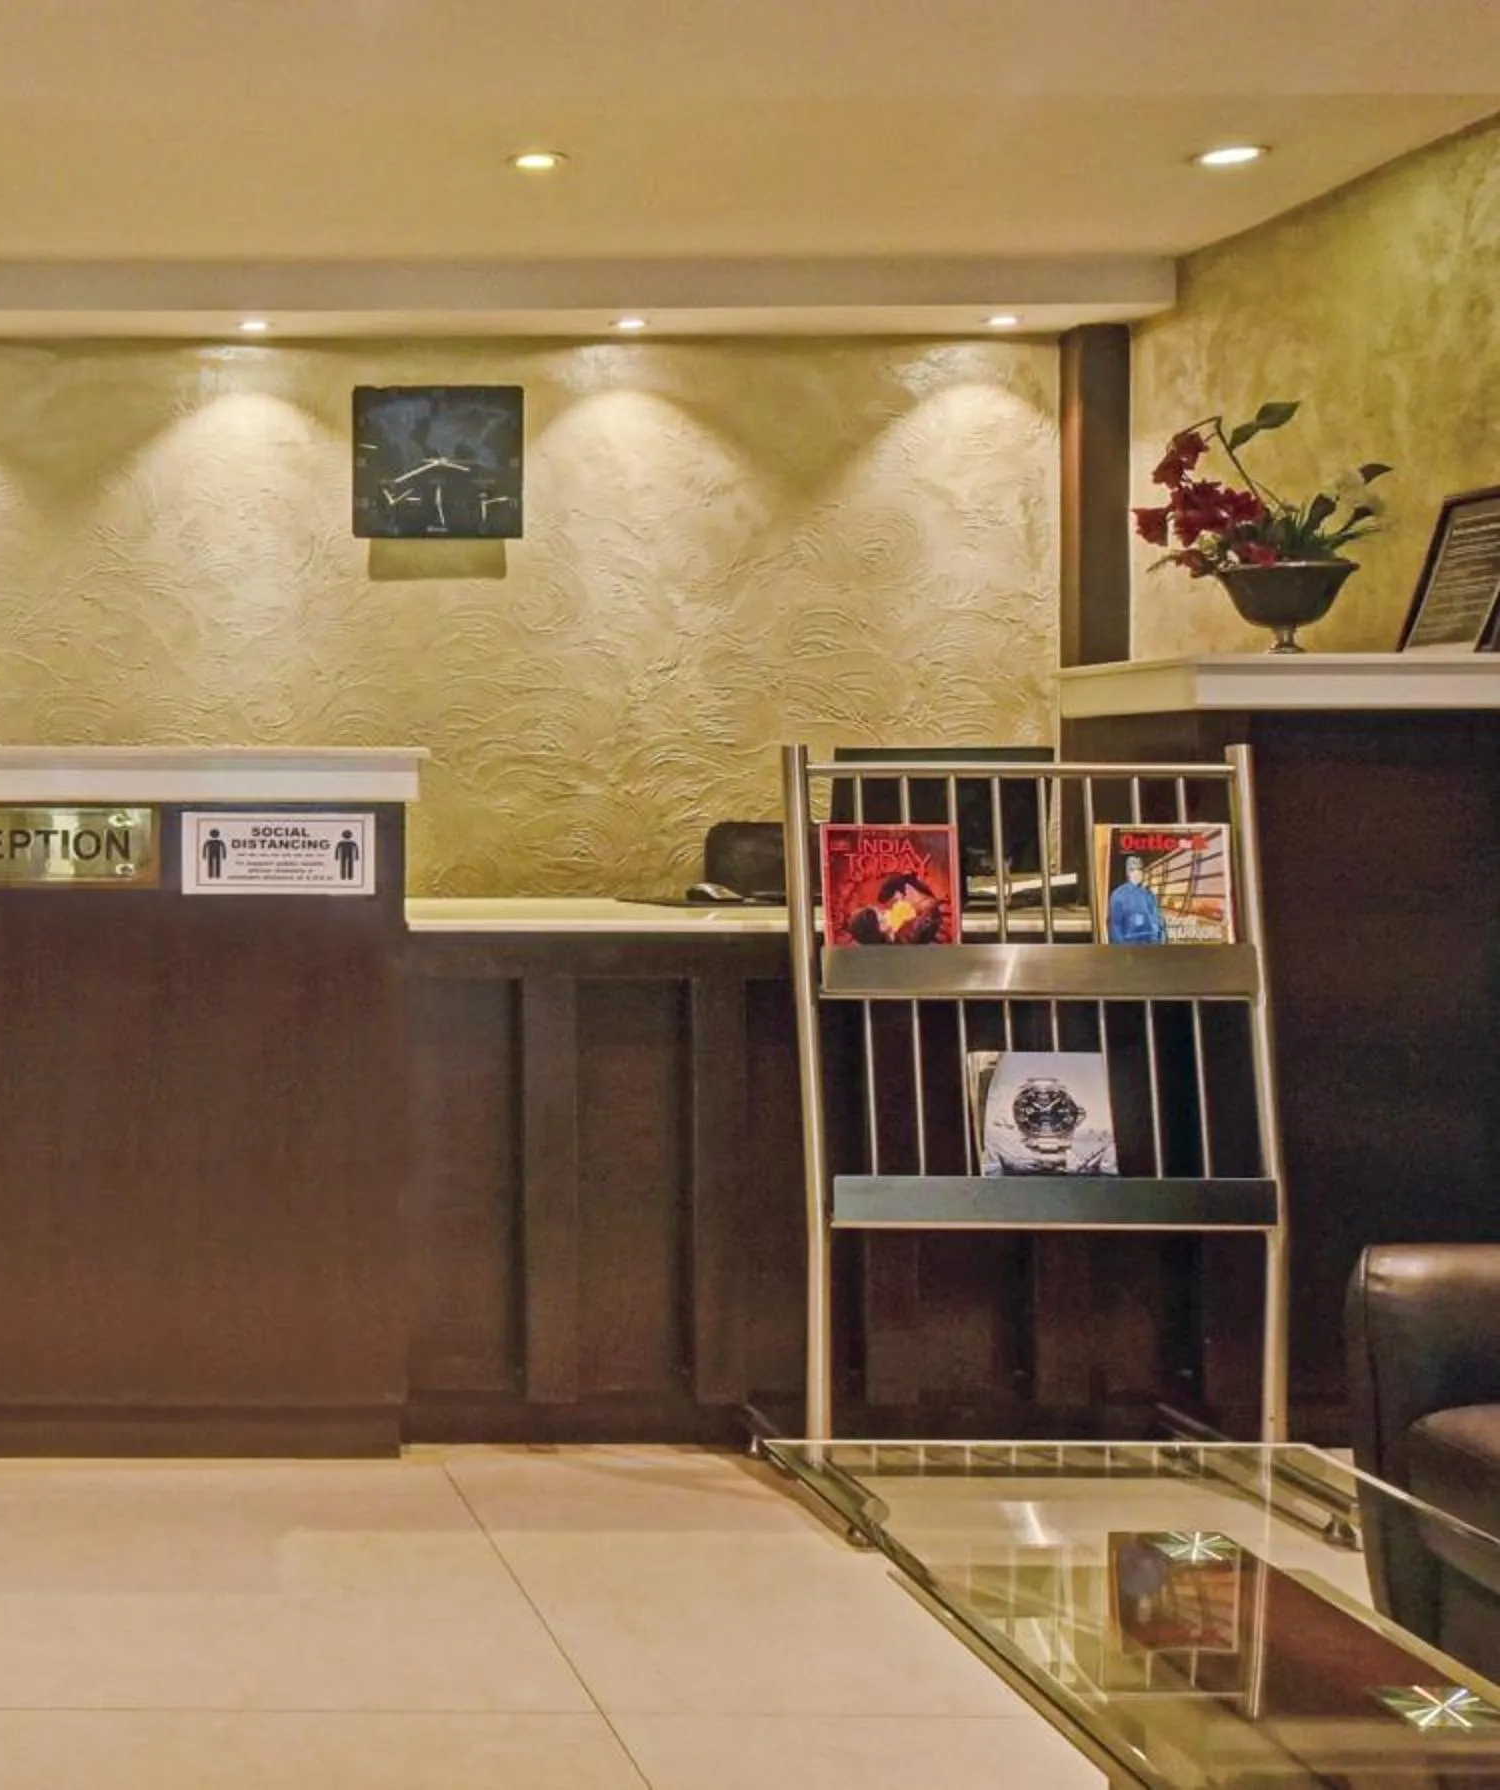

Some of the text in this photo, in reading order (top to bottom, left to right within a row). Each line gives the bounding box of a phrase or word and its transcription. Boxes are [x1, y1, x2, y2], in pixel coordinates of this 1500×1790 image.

[251, 826, 310, 838] SOCIAL
[231, 839, 331, 850] DISTANCING
[858, 838, 916, 855] INDIA
[844, 853, 931, 879] TODAY
